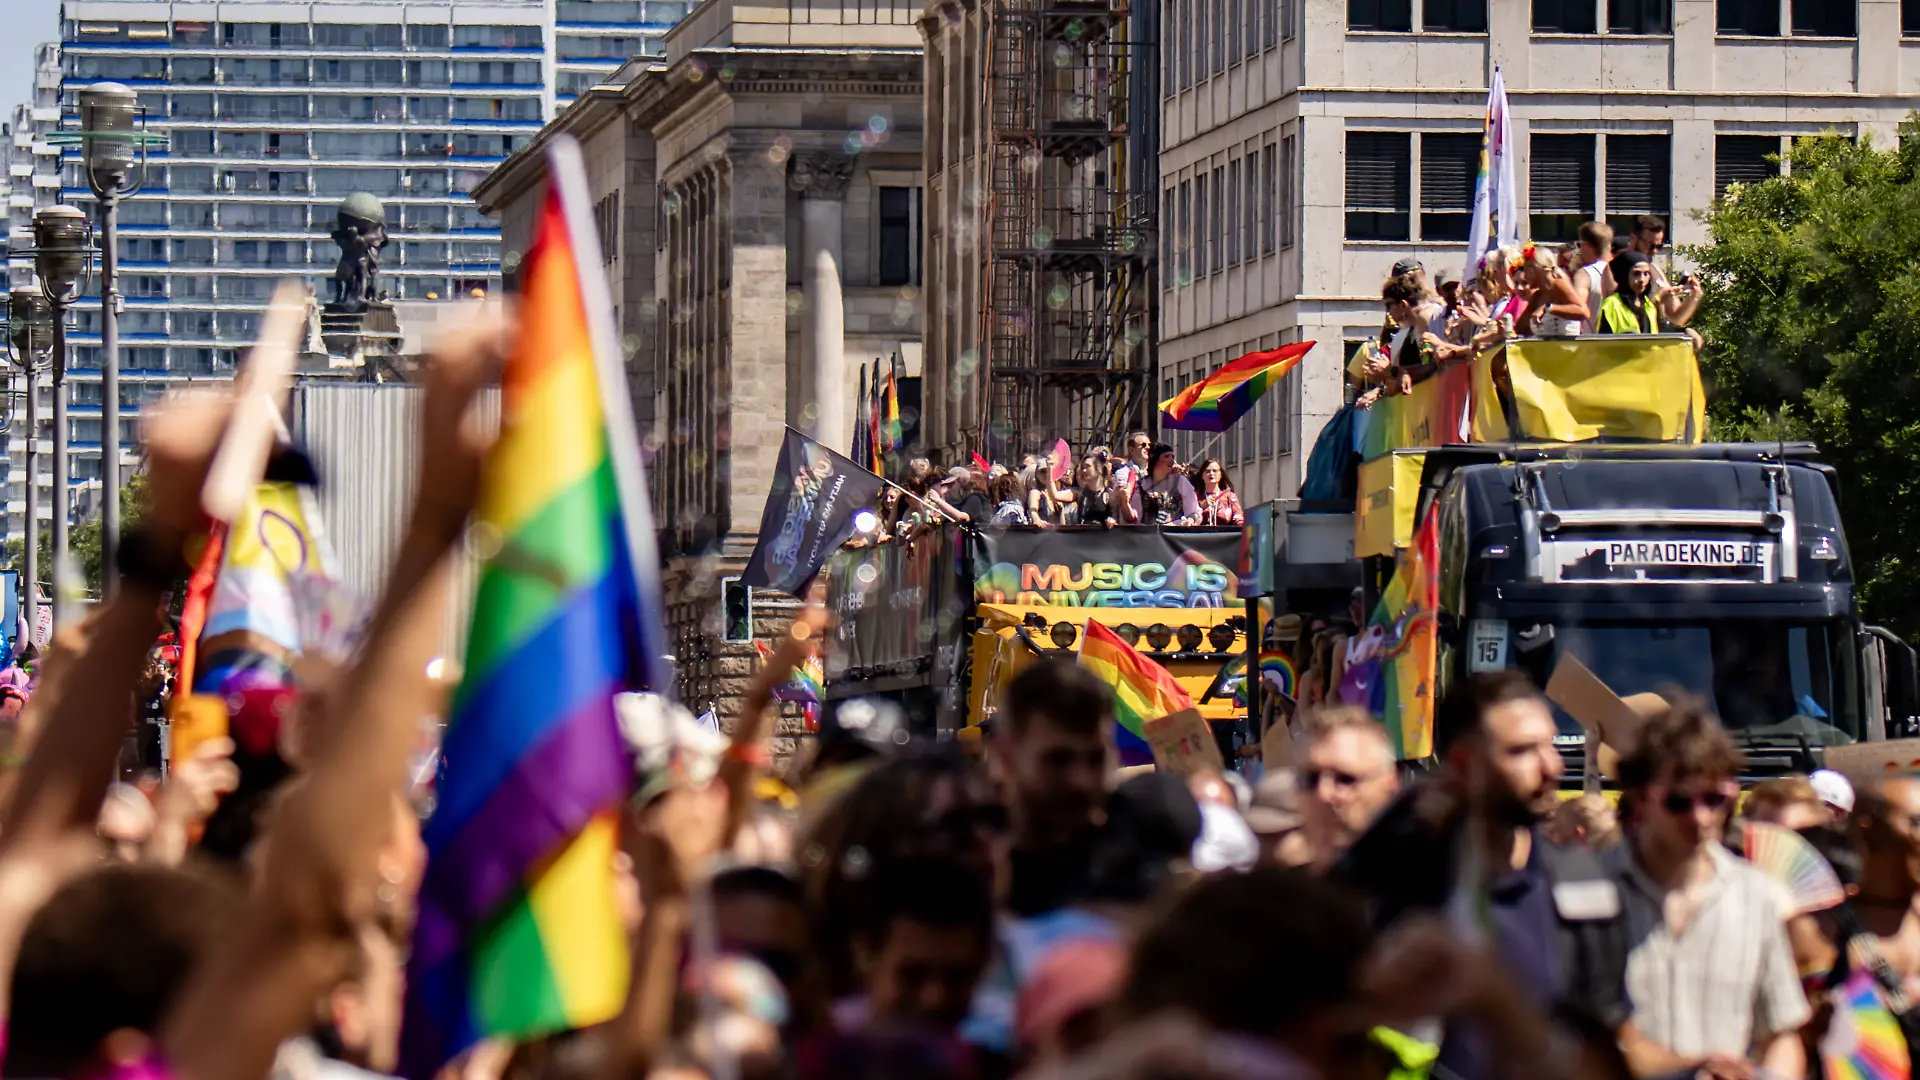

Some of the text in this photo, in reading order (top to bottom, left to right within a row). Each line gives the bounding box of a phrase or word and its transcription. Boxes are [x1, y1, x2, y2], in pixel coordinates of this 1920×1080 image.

[1610, 544, 1764, 565] PARADEKING.DE
[1021, 563, 1228, 591] MUSIC IS
[1477, 641, 1499, 663] 15
